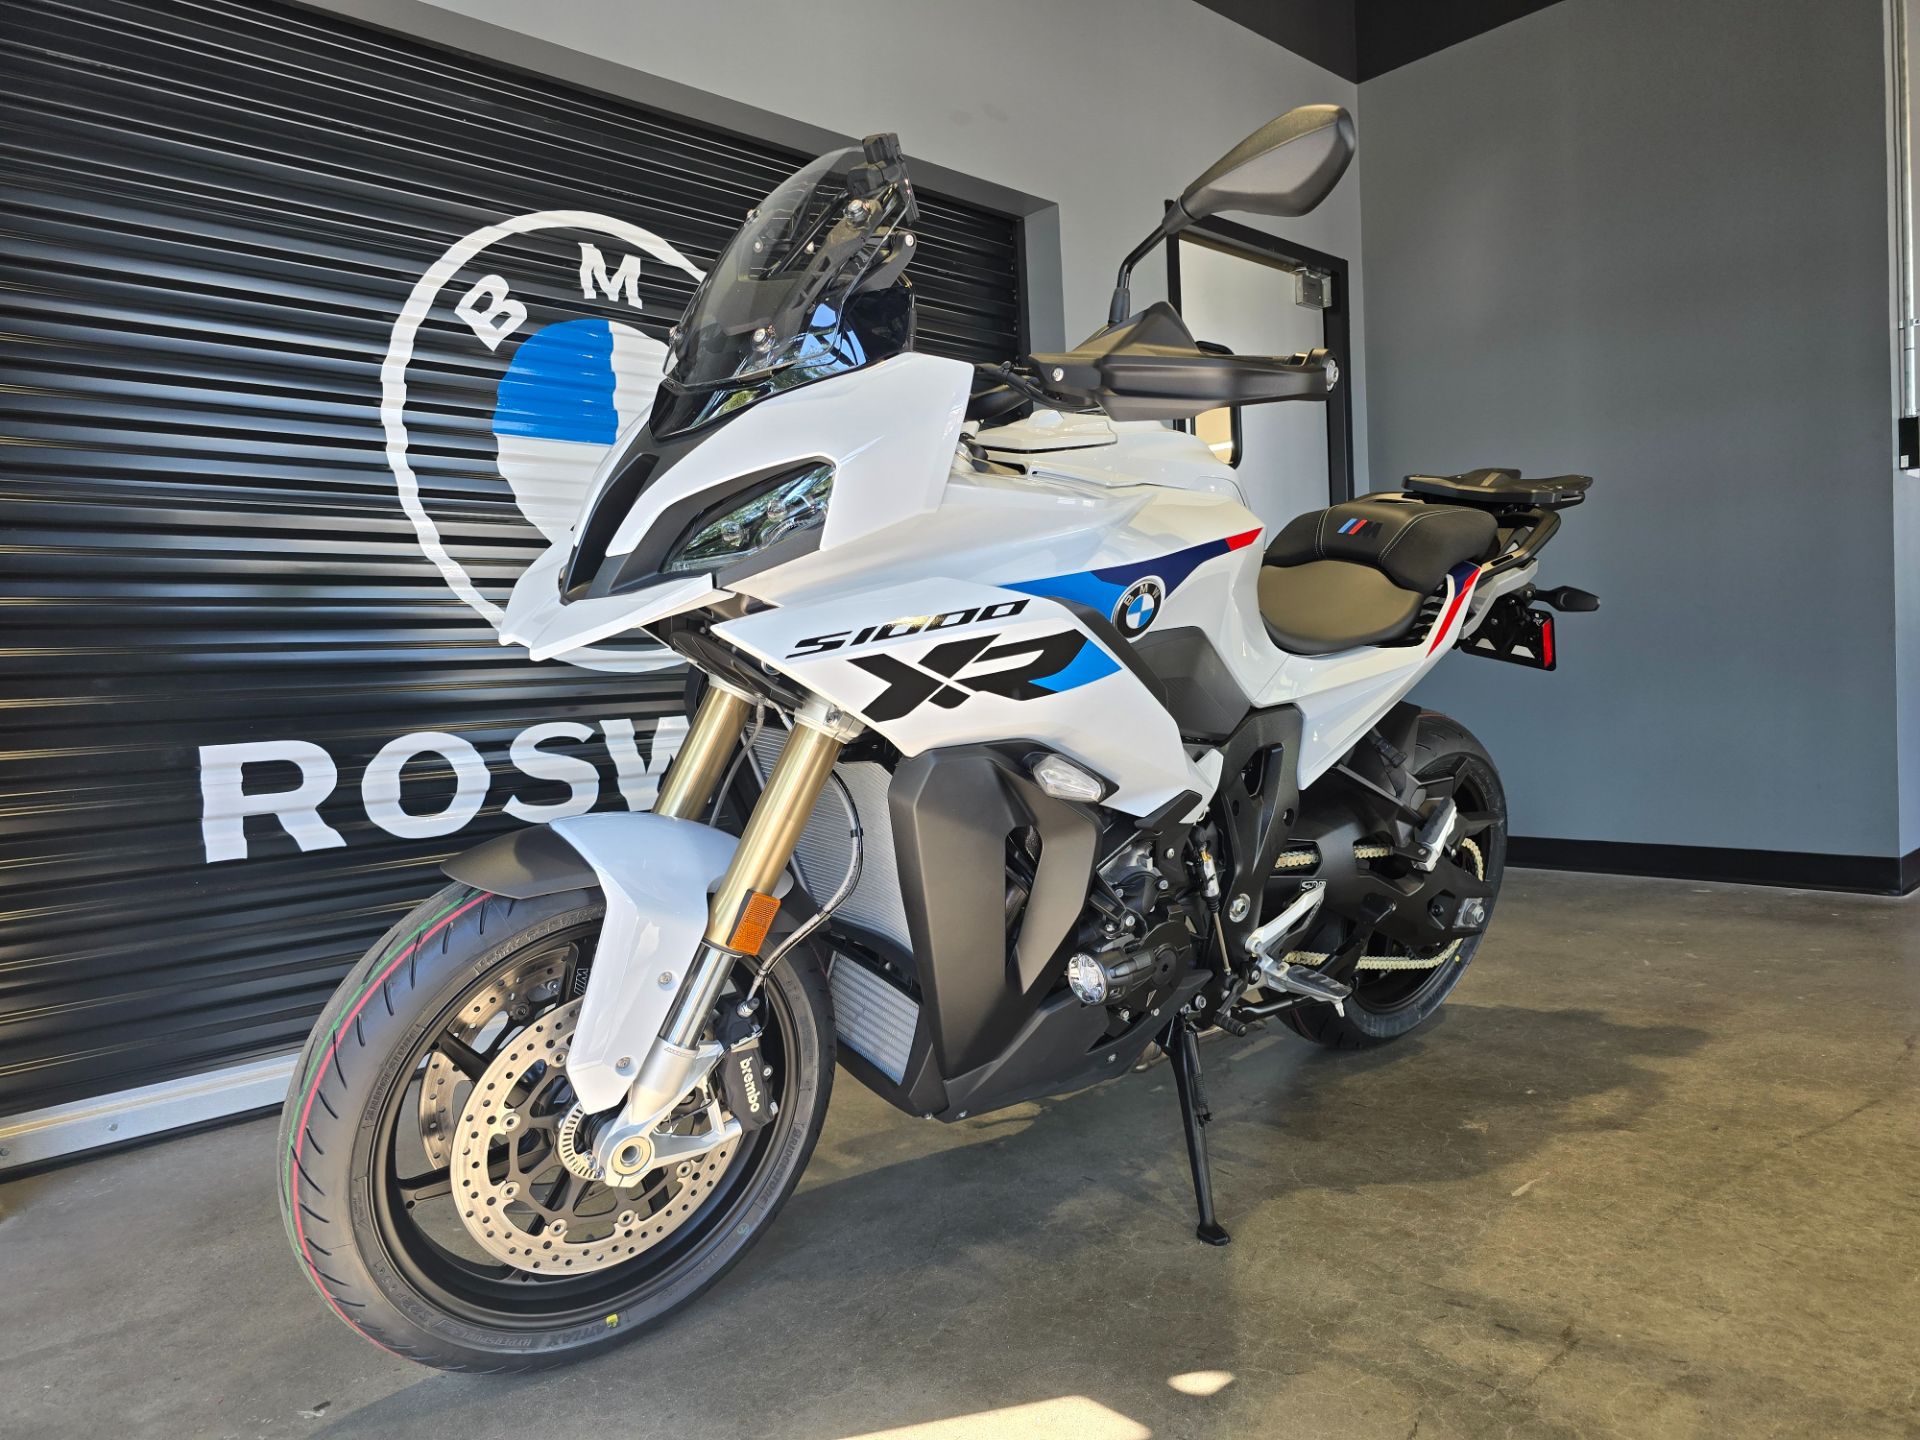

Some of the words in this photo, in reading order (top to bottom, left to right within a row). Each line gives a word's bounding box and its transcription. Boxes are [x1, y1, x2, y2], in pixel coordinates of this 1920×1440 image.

[1124, 583, 1161, 607] BMW
[785, 598, 1031, 660] S1000
[845, 628, 1092, 723] XR
[739, 1056, 760, 1113] brembo
[760, 1127, 803, 1203] BRIDGESTONE
